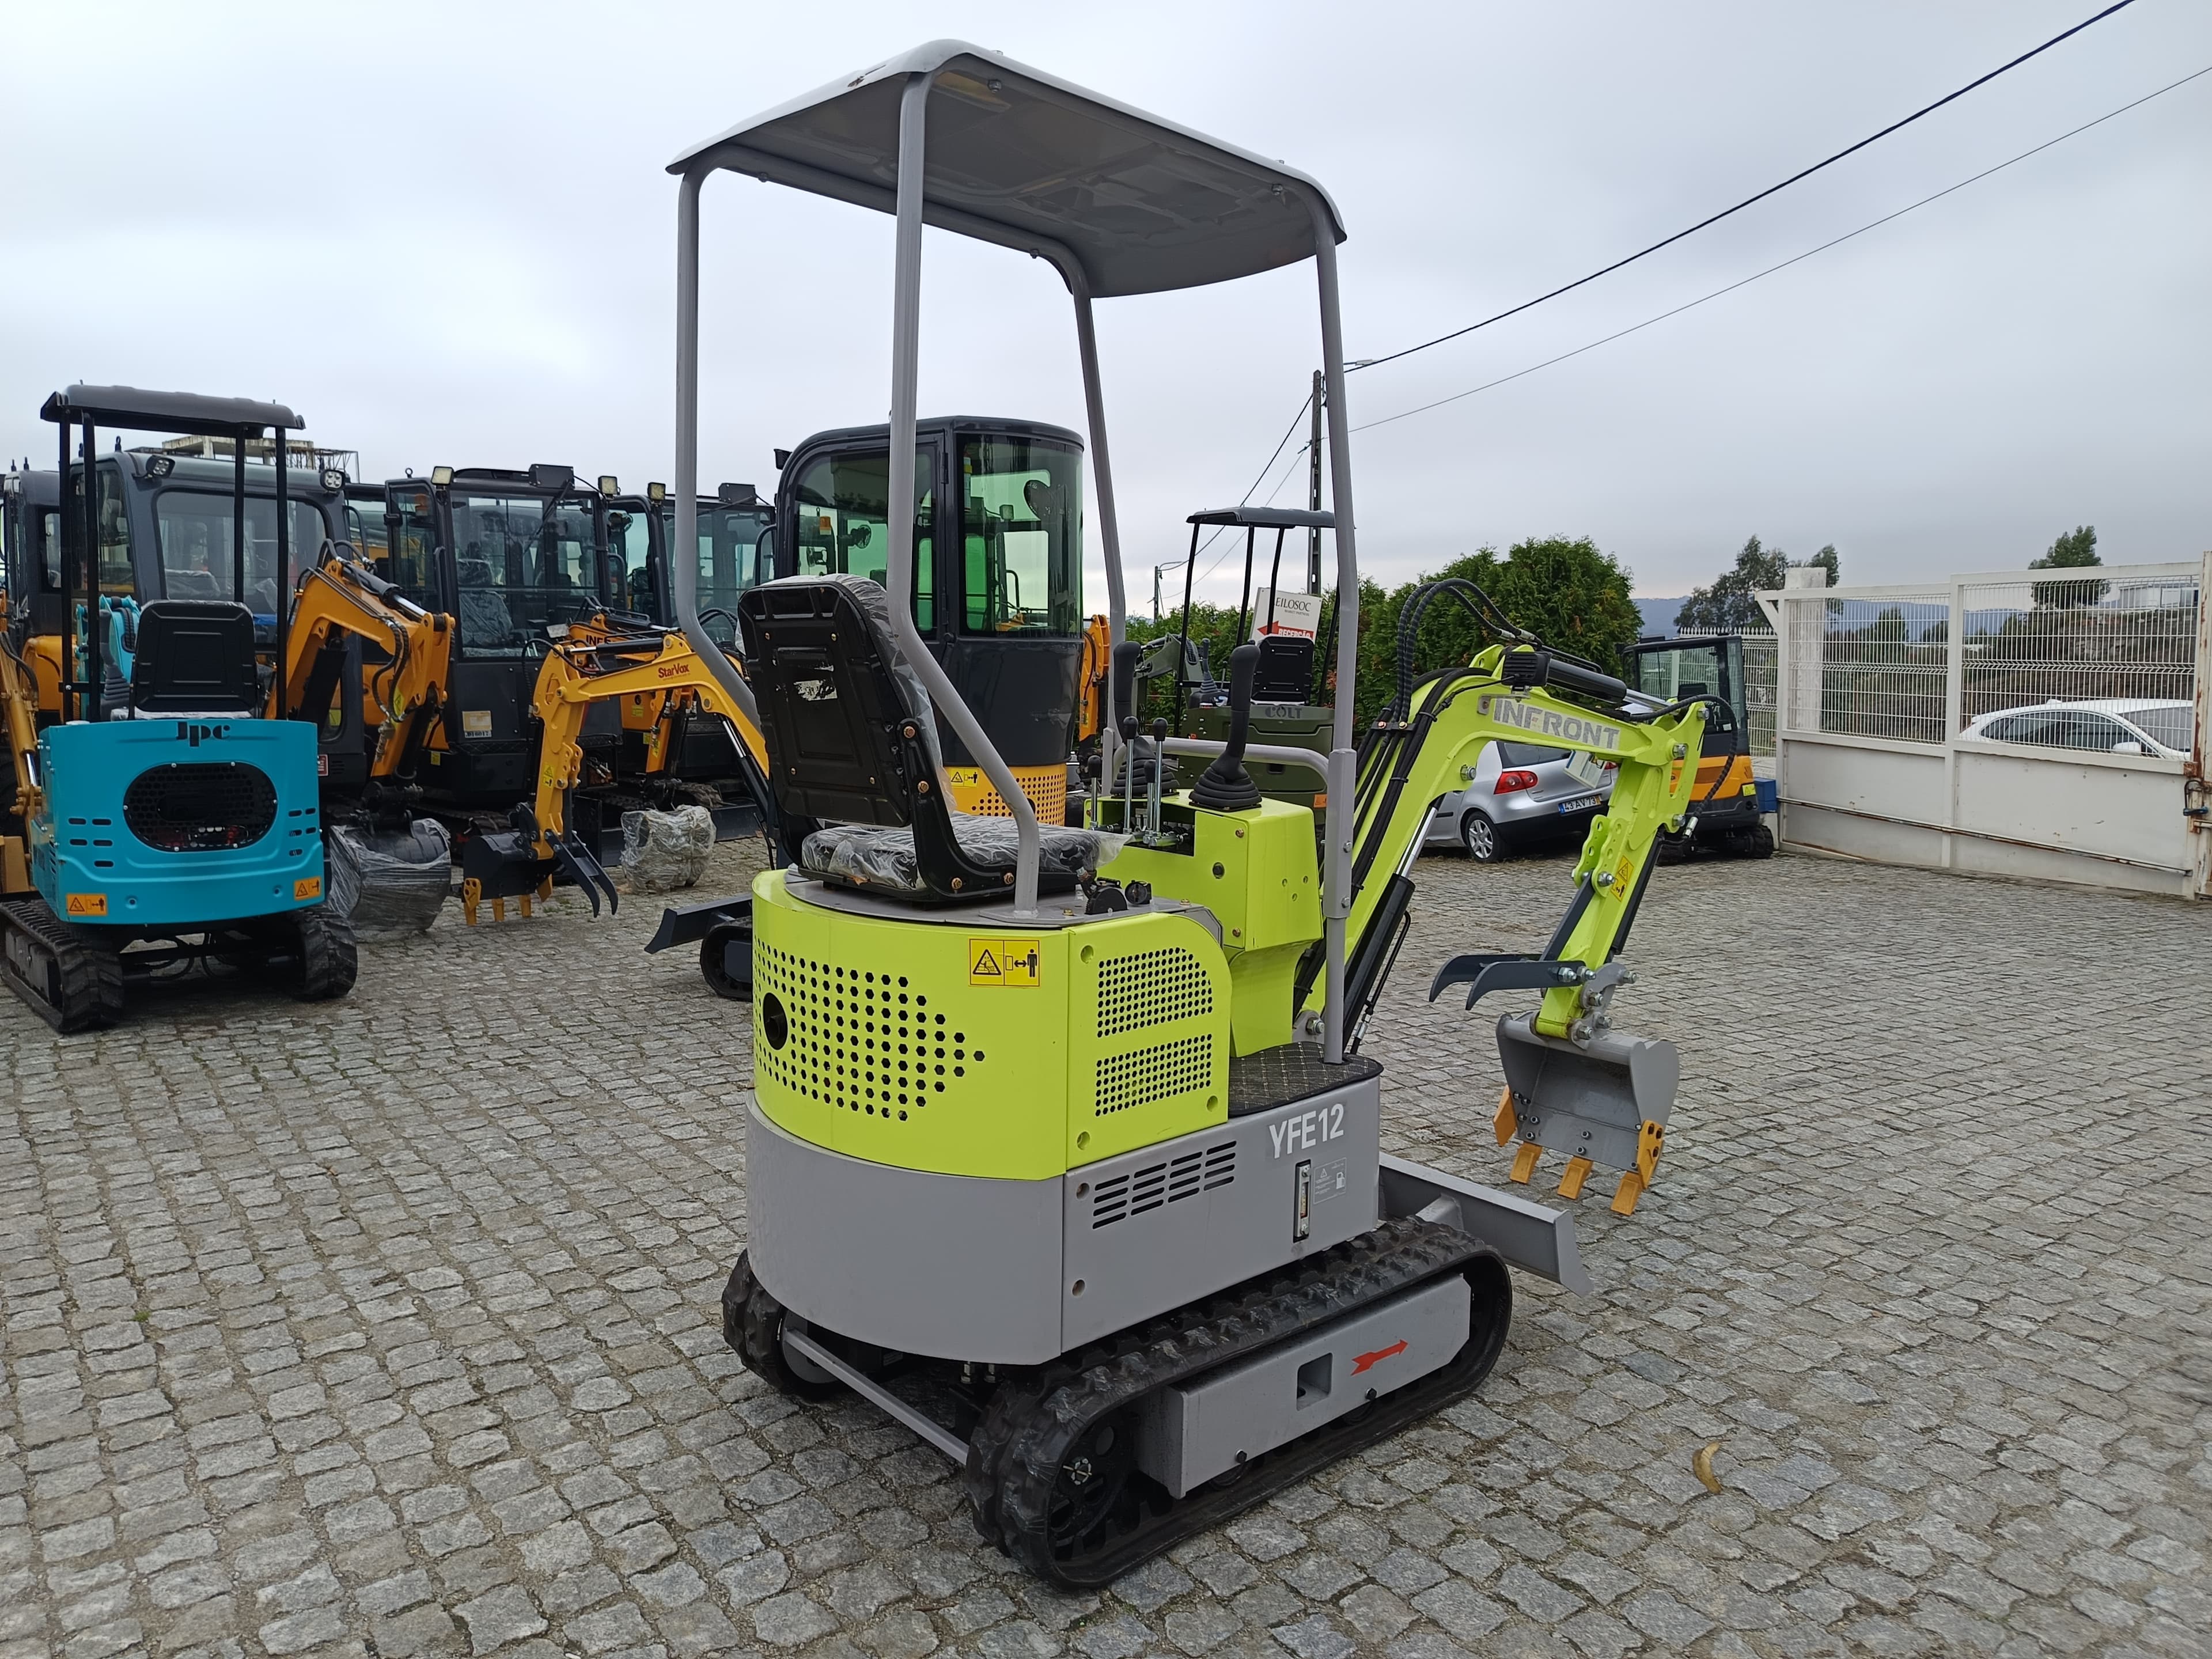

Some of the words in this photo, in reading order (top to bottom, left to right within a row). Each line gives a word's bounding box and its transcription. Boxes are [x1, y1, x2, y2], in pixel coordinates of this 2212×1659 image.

[1275, 597, 1311, 612] EILOSOC
[658, 663, 690, 678] StarVox
[1265, 706, 1302, 719] COLT
[1493, 698, 1620, 749] INFRONT
[1269, 1103, 1344, 1159] YFE12
